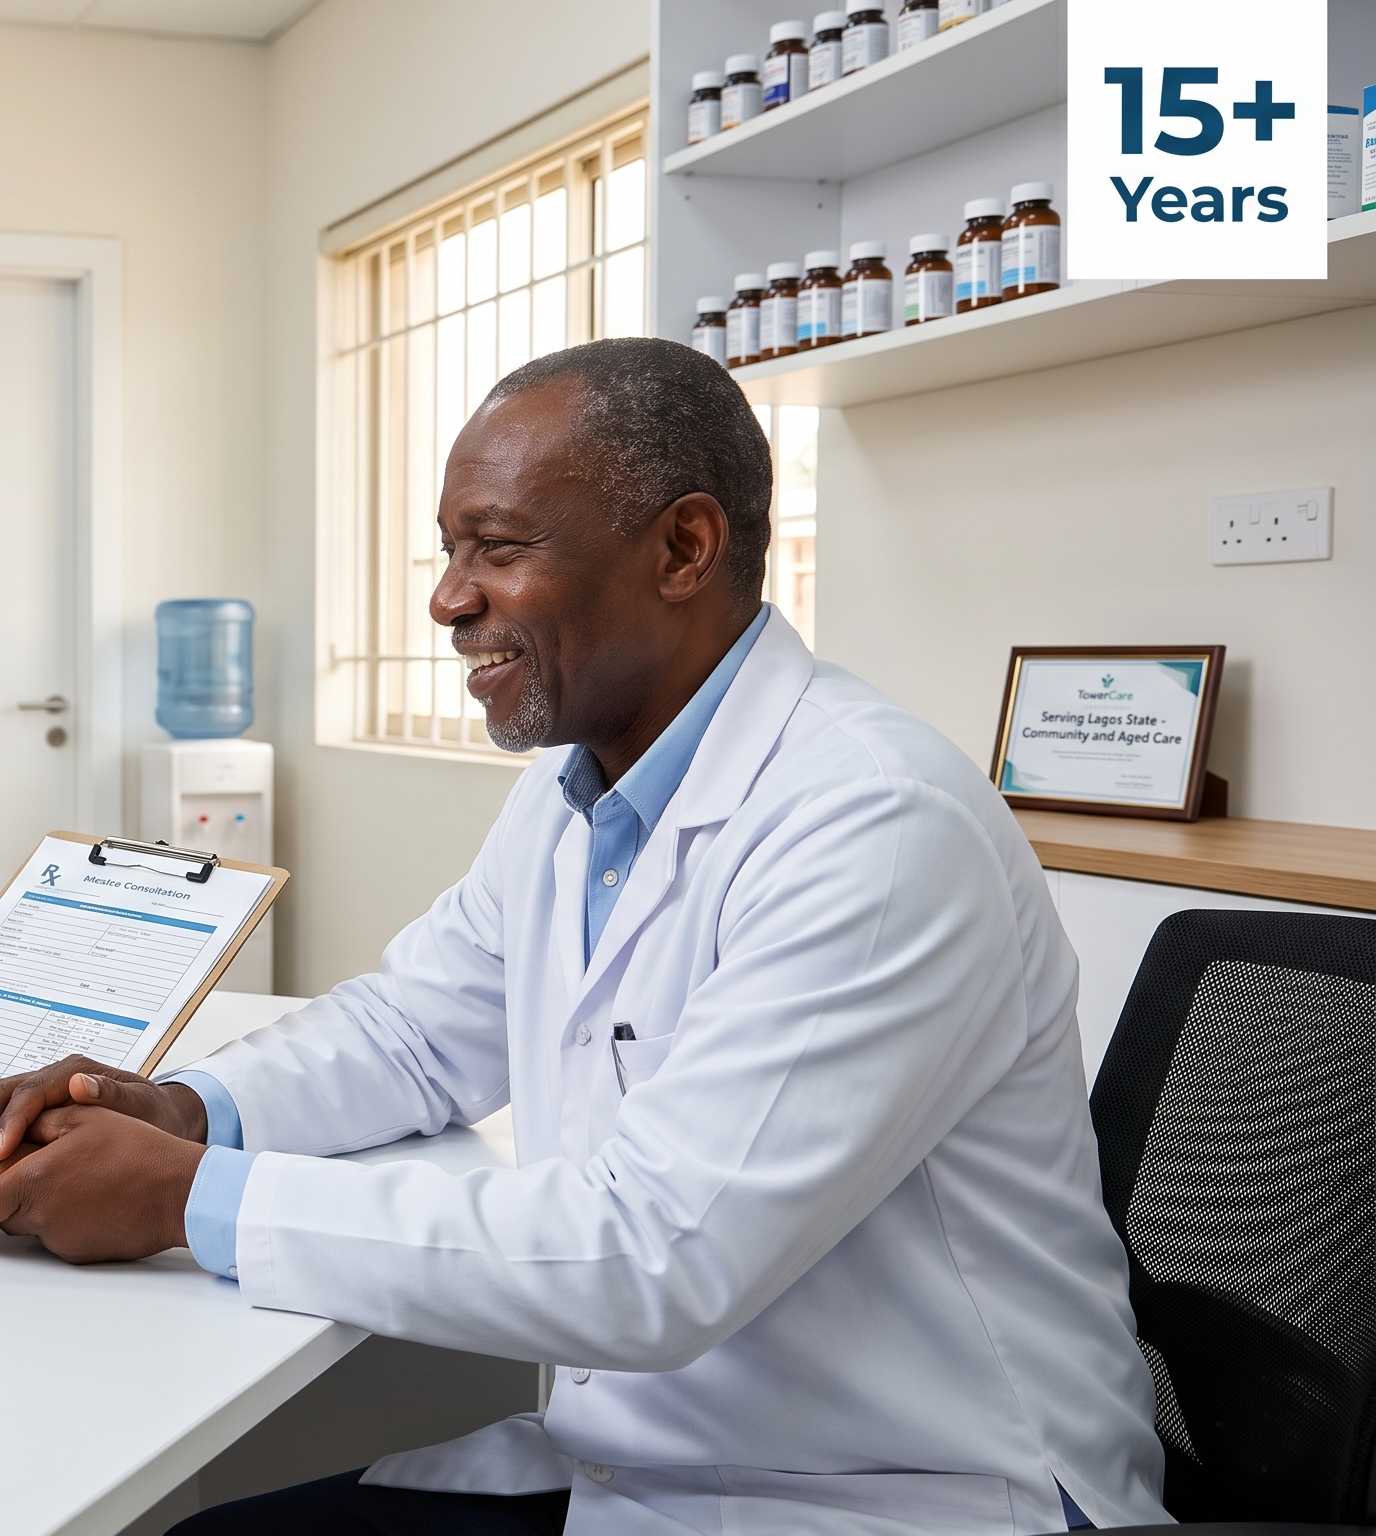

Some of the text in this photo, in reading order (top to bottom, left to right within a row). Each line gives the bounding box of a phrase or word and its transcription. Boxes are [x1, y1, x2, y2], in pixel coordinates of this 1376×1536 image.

[1077, 689, 1134, 702] TowerCare
[1041, 711, 1085, 727] Serving
[1087, 712, 1123, 728] Lagos
[1125, 713, 1158, 727] State
[1022, 727, 1182, 746] Community and Aged Care
